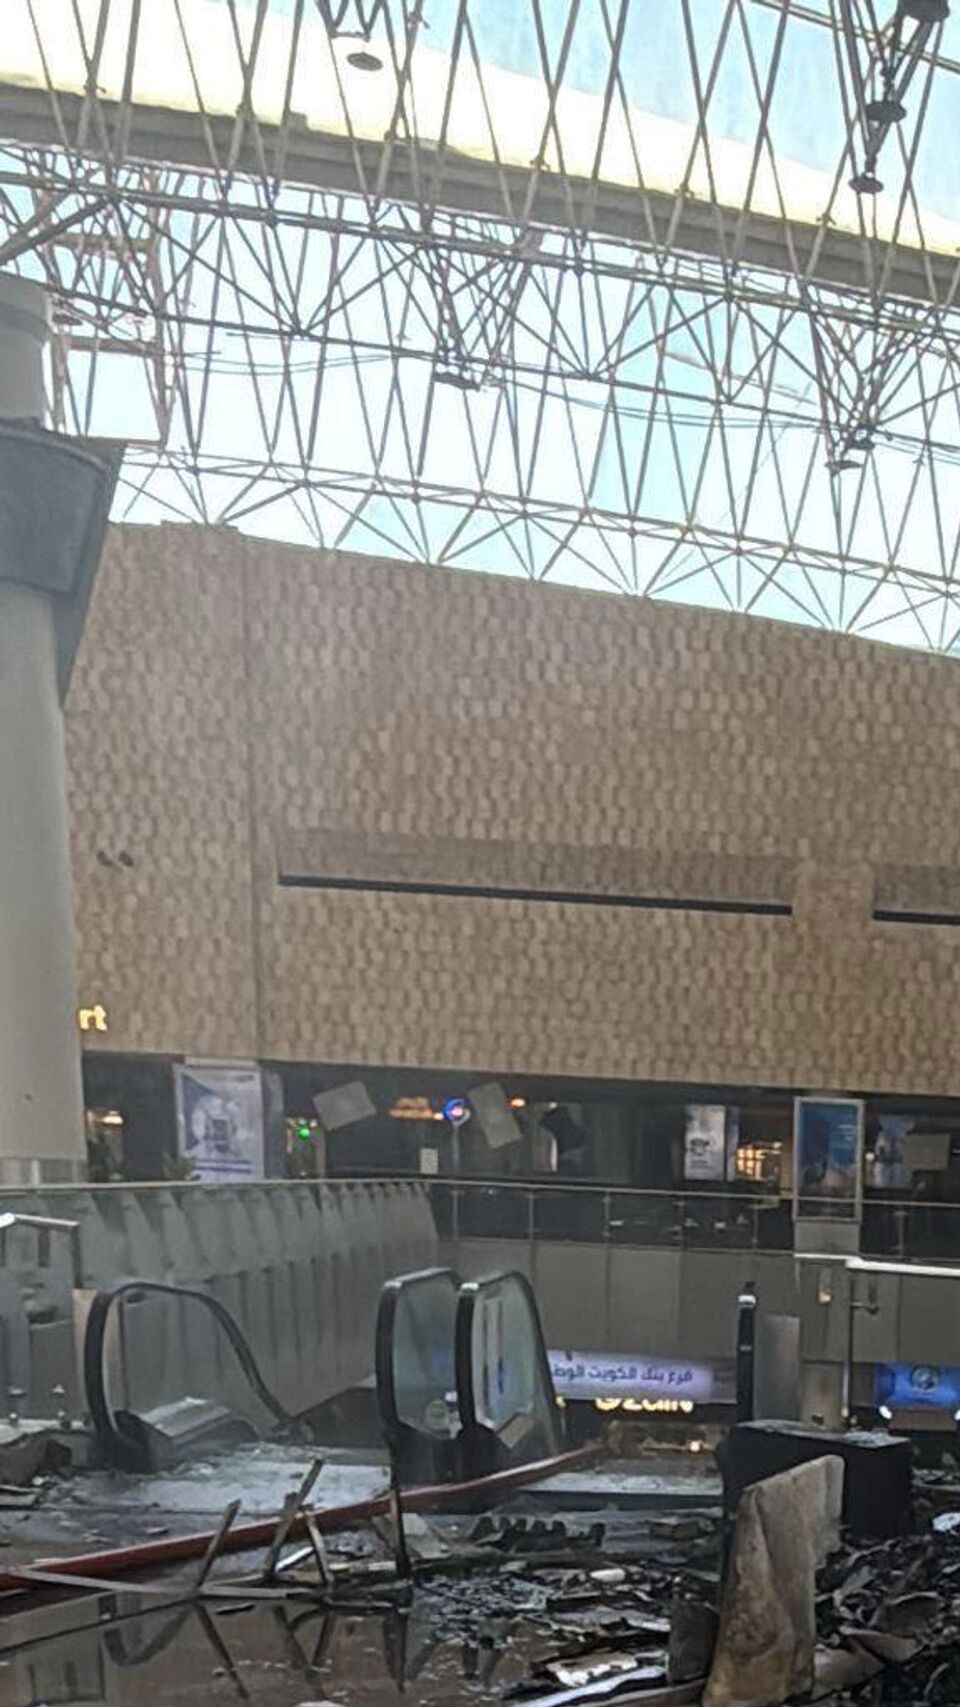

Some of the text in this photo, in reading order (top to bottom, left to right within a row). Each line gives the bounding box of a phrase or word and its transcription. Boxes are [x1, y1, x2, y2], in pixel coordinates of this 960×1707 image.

[588, 1365, 637, 1381] الكويت
[640, 1367, 664, 1382] بنك
[667, 1368, 693, 1385] فرع
